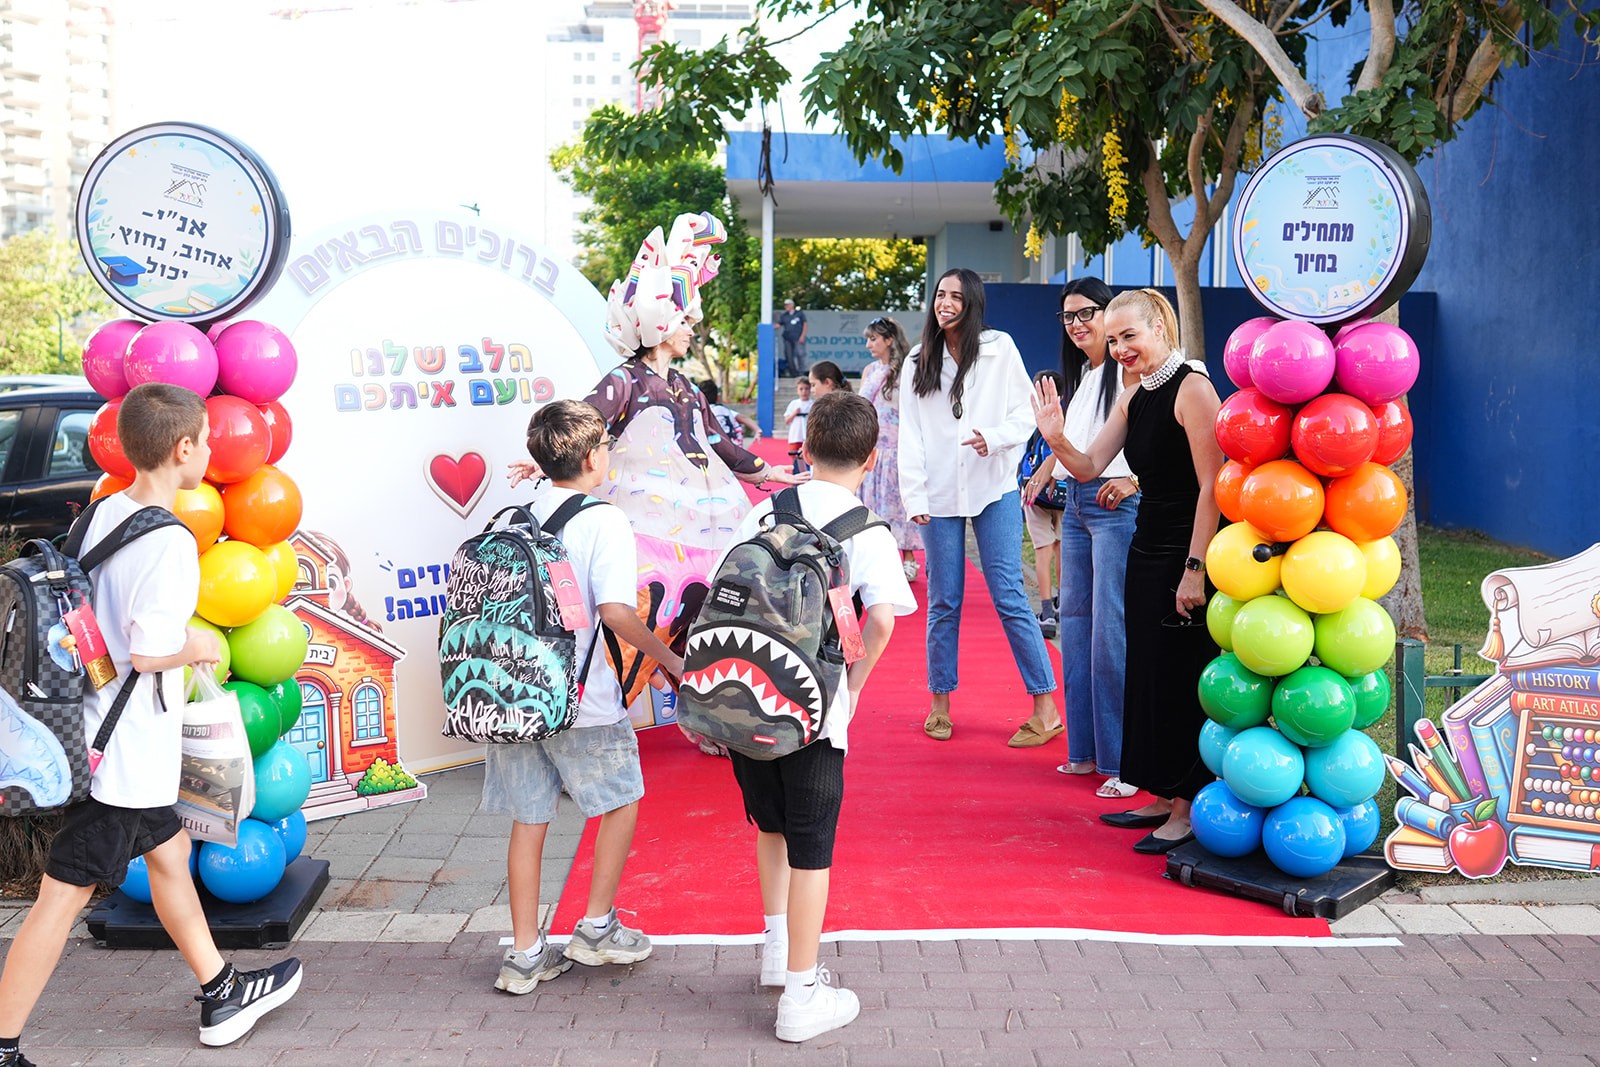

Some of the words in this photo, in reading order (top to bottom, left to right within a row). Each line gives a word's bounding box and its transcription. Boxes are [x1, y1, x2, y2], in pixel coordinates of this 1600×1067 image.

[110, 225, 167, 251] נחוץ,
[1282, 221, 1354, 242] מתחילים
[146, 256, 188, 280] יכול
[172, 243, 233, 271] אהוב,
[288, 220, 423, 295] הבאים
[436, 220, 560, 296] ברוכים
[1294, 253, 1337, 274] בחיוך
[351, 339, 446, 377] שלנו
[458, 337, 533, 373] הלב
[334, 380, 457, 412] איתכם
[469, 377, 555, 406] פועם
[309, 649, 330, 660] בית
[1531, 672, 1590, 690] HISTORY
[1533, 697, 1556, 711] ART
[1559, 700, 1598, 716] ATLAS
